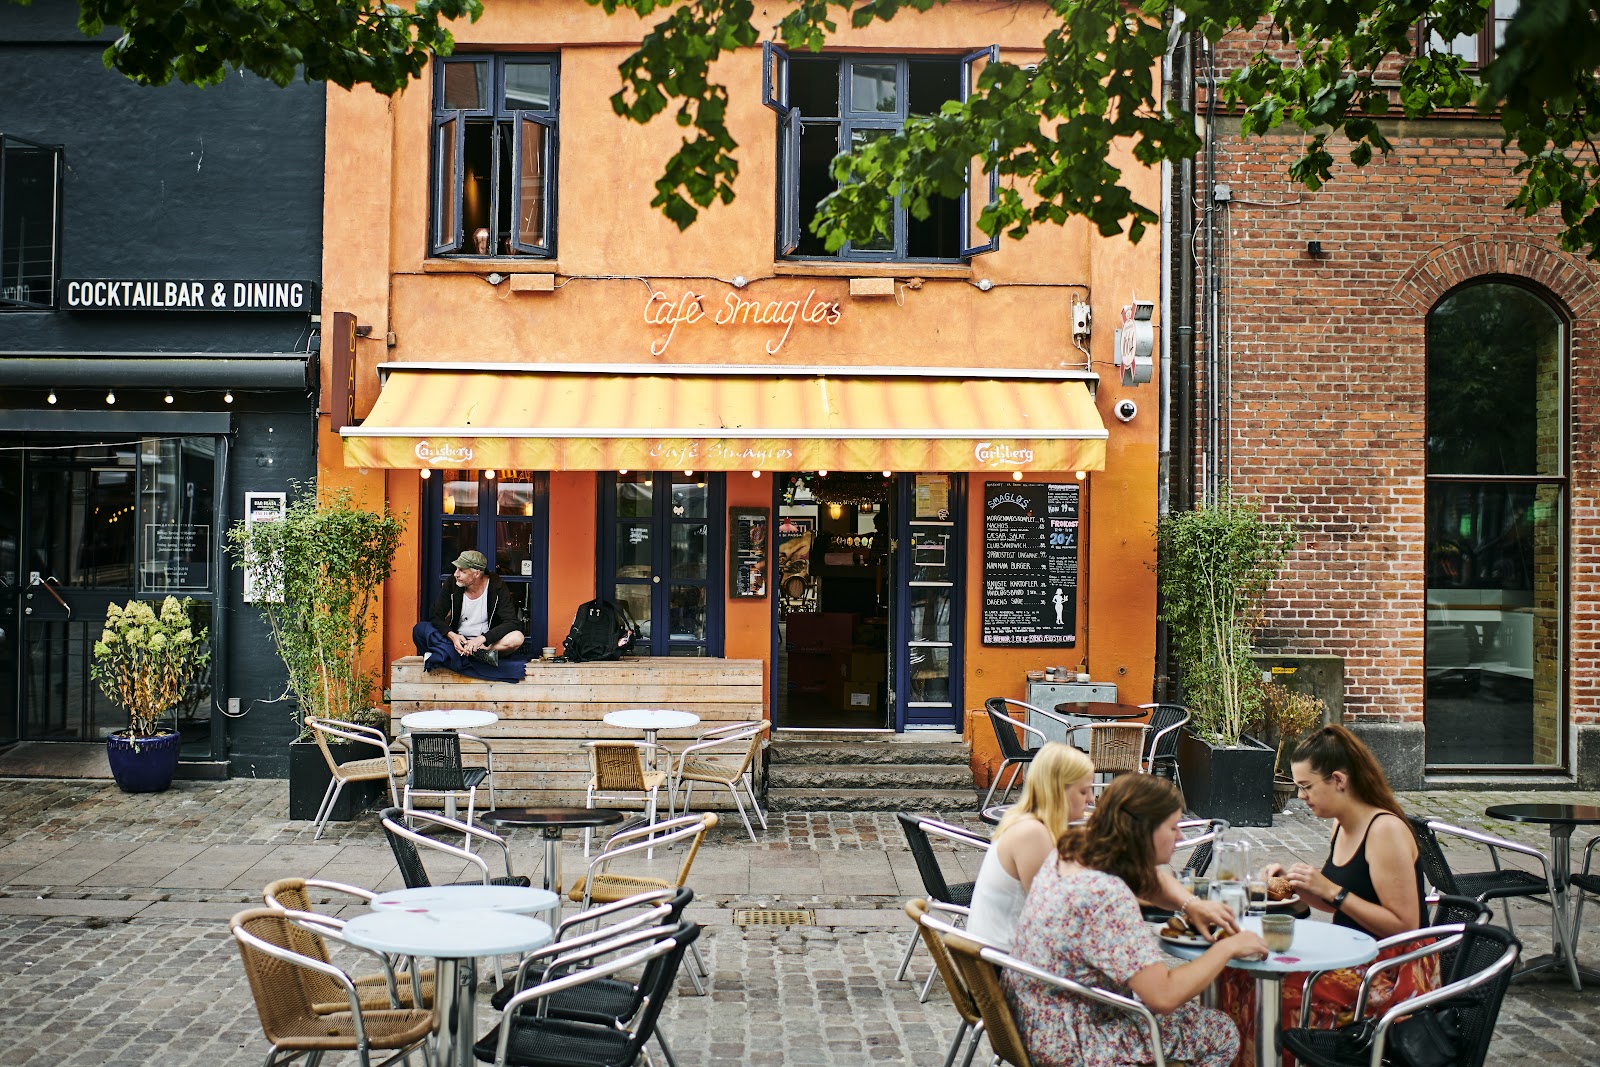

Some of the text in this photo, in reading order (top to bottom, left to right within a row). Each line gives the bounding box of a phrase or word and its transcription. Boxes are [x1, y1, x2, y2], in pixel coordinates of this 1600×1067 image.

[68, 282, 303, 307] COCKTAILBAR & DINING
[643, 288, 842, 356] Café Smagløs
[347, 320, 356, 426] BAR
[975, 442, 1034, 467] Carlsberg
[1049, 532, 1075, 546] 20%
